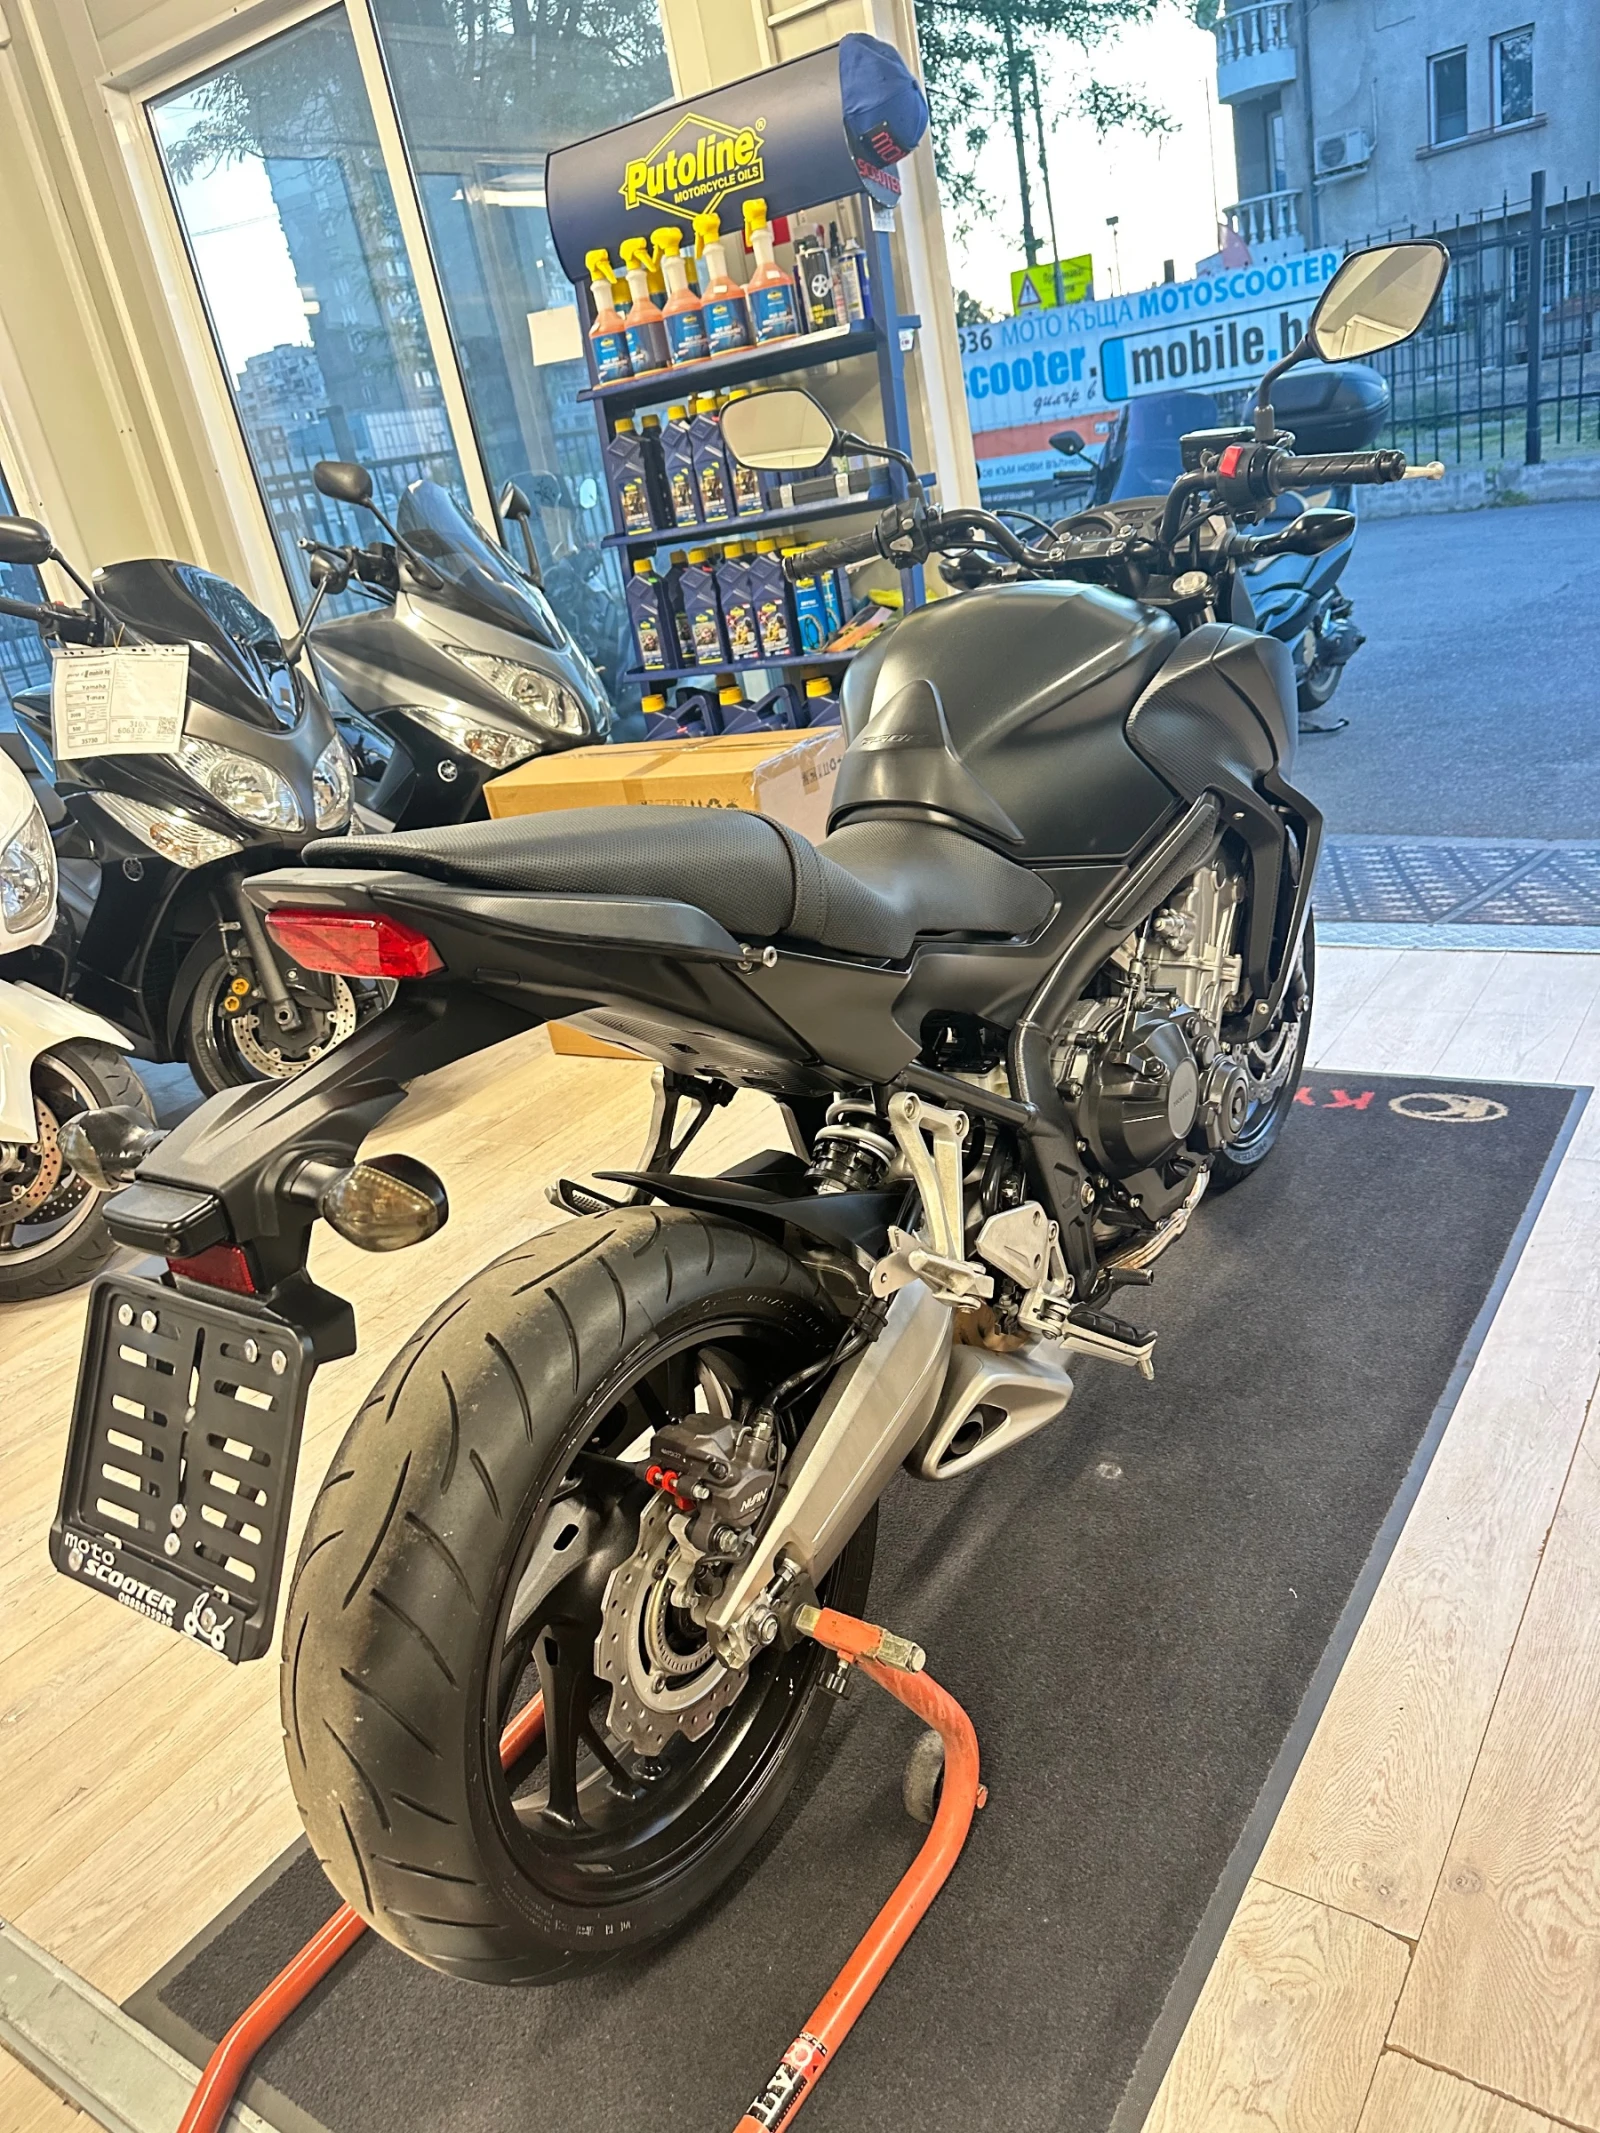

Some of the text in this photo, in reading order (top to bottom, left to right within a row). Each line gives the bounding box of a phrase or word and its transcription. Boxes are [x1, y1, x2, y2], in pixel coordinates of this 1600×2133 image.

[628, 132, 755, 204] Putoline
[674, 166, 759, 204] MOTORCYCLE OILS
[1002, 314, 1061, 346] МОТО
[1067, 304, 1134, 333] КЪЩА
[1138, 251, 1339, 319] MOTOSCOOTER
[964, 312, 1311, 399] cooter. mobile.b
[81, 683, 106, 691] Yamaha
[64, 1532, 115, 1566] moto
[83, 1558, 177, 1616] SCOOTER
[117, 1592, 173, 1628] 0888835936
